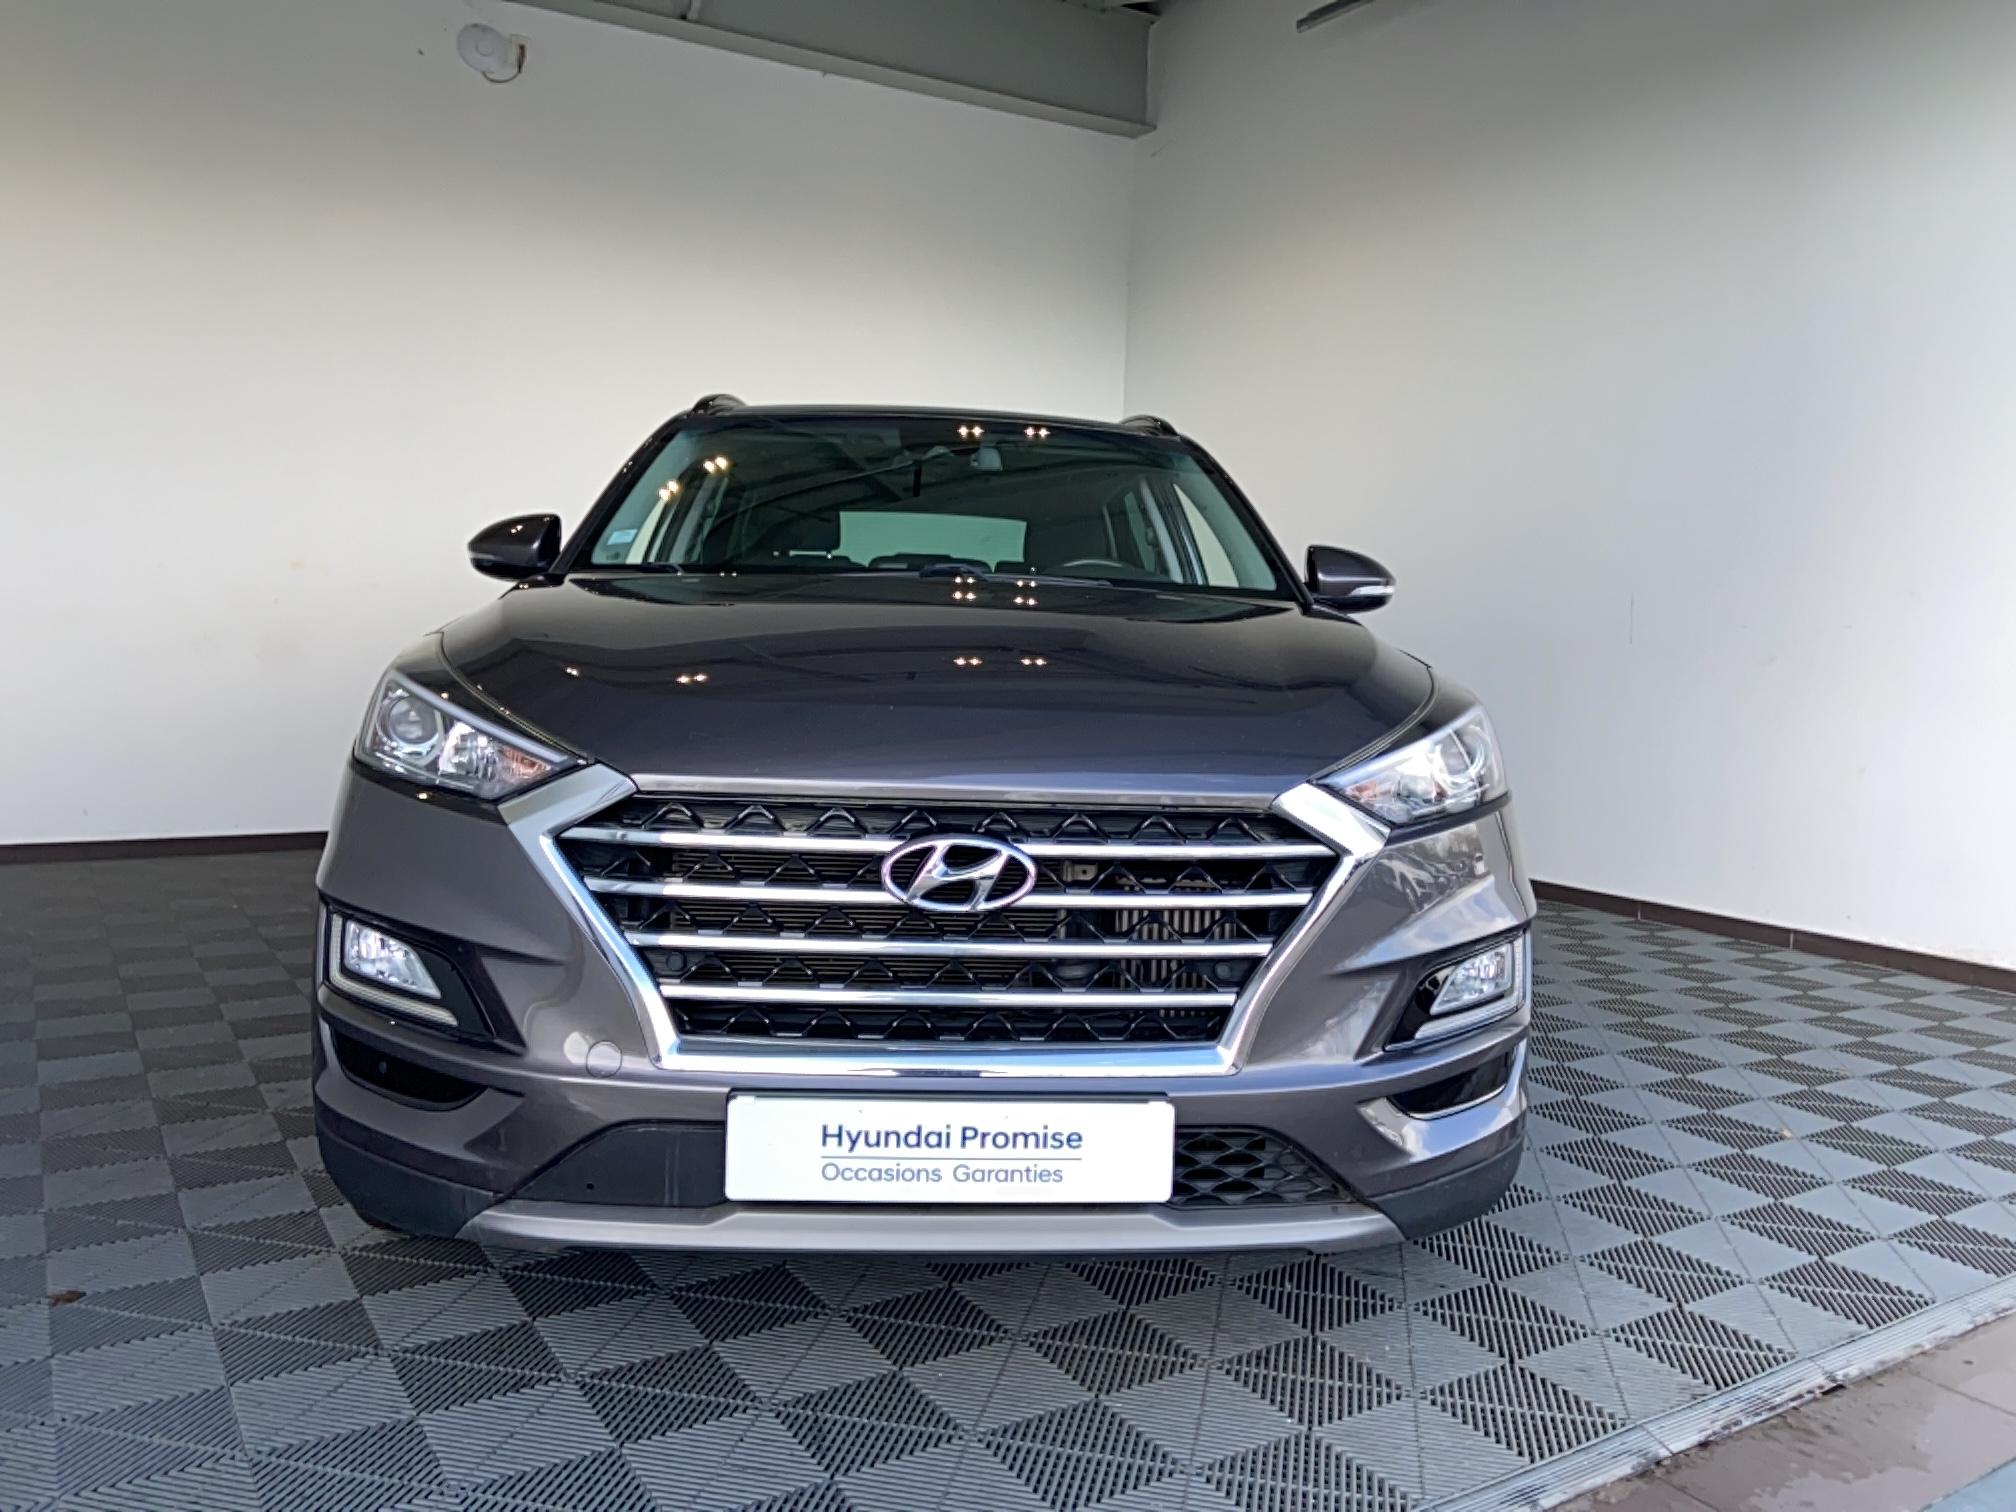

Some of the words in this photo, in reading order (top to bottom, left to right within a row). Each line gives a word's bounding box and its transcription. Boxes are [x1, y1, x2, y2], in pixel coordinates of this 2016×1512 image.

[821, 1123, 951, 1153] Hyundai
[960, 1124, 1084, 1150] Promise
[821, 1162, 943, 1183] Occasions
[952, 1163, 1064, 1183] Garanties
